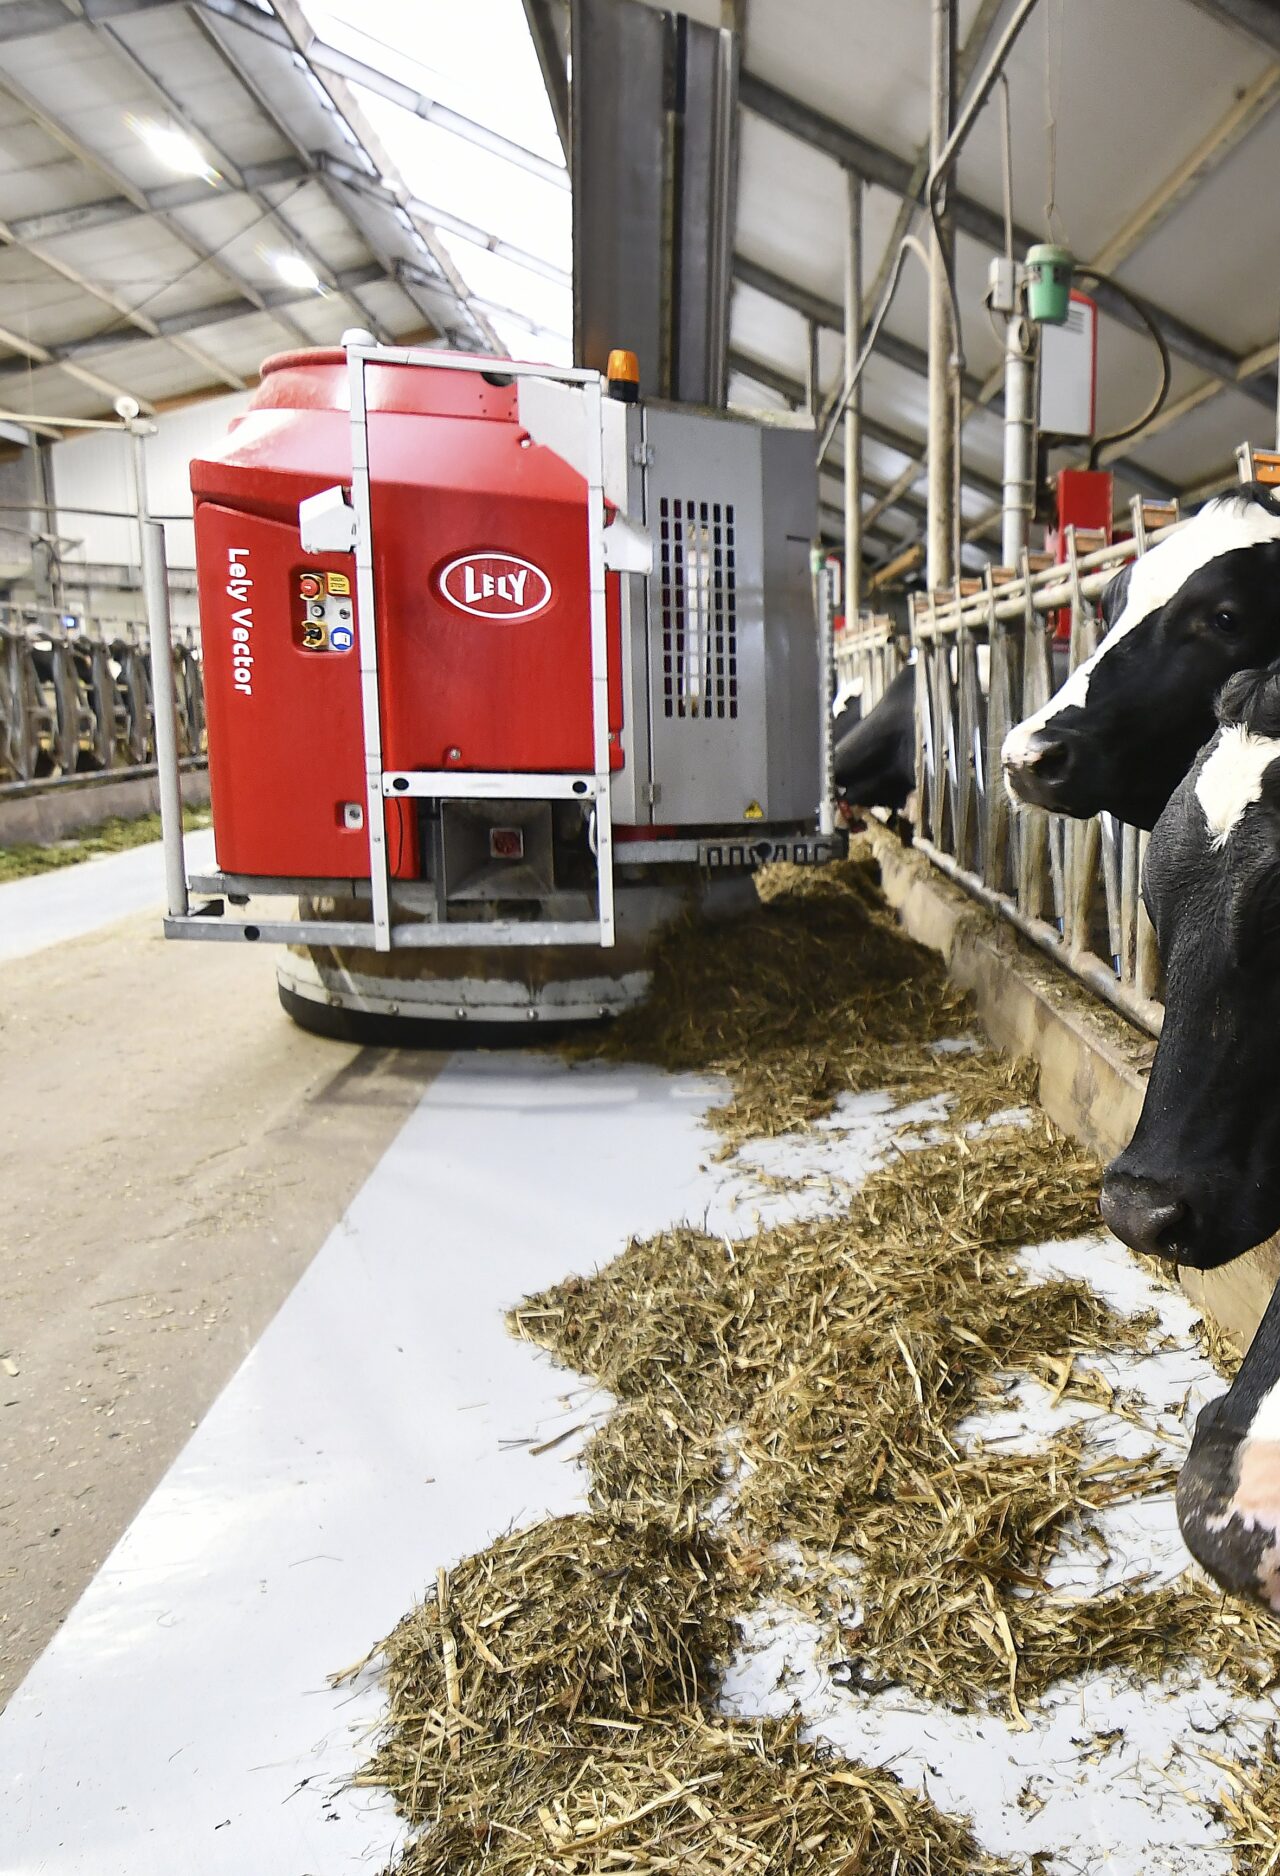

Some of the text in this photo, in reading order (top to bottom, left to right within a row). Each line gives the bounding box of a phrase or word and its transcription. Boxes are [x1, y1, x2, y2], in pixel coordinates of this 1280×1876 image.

[226, 548, 254, 695] Lely Vector
[465, 565, 528, 606] LELY
